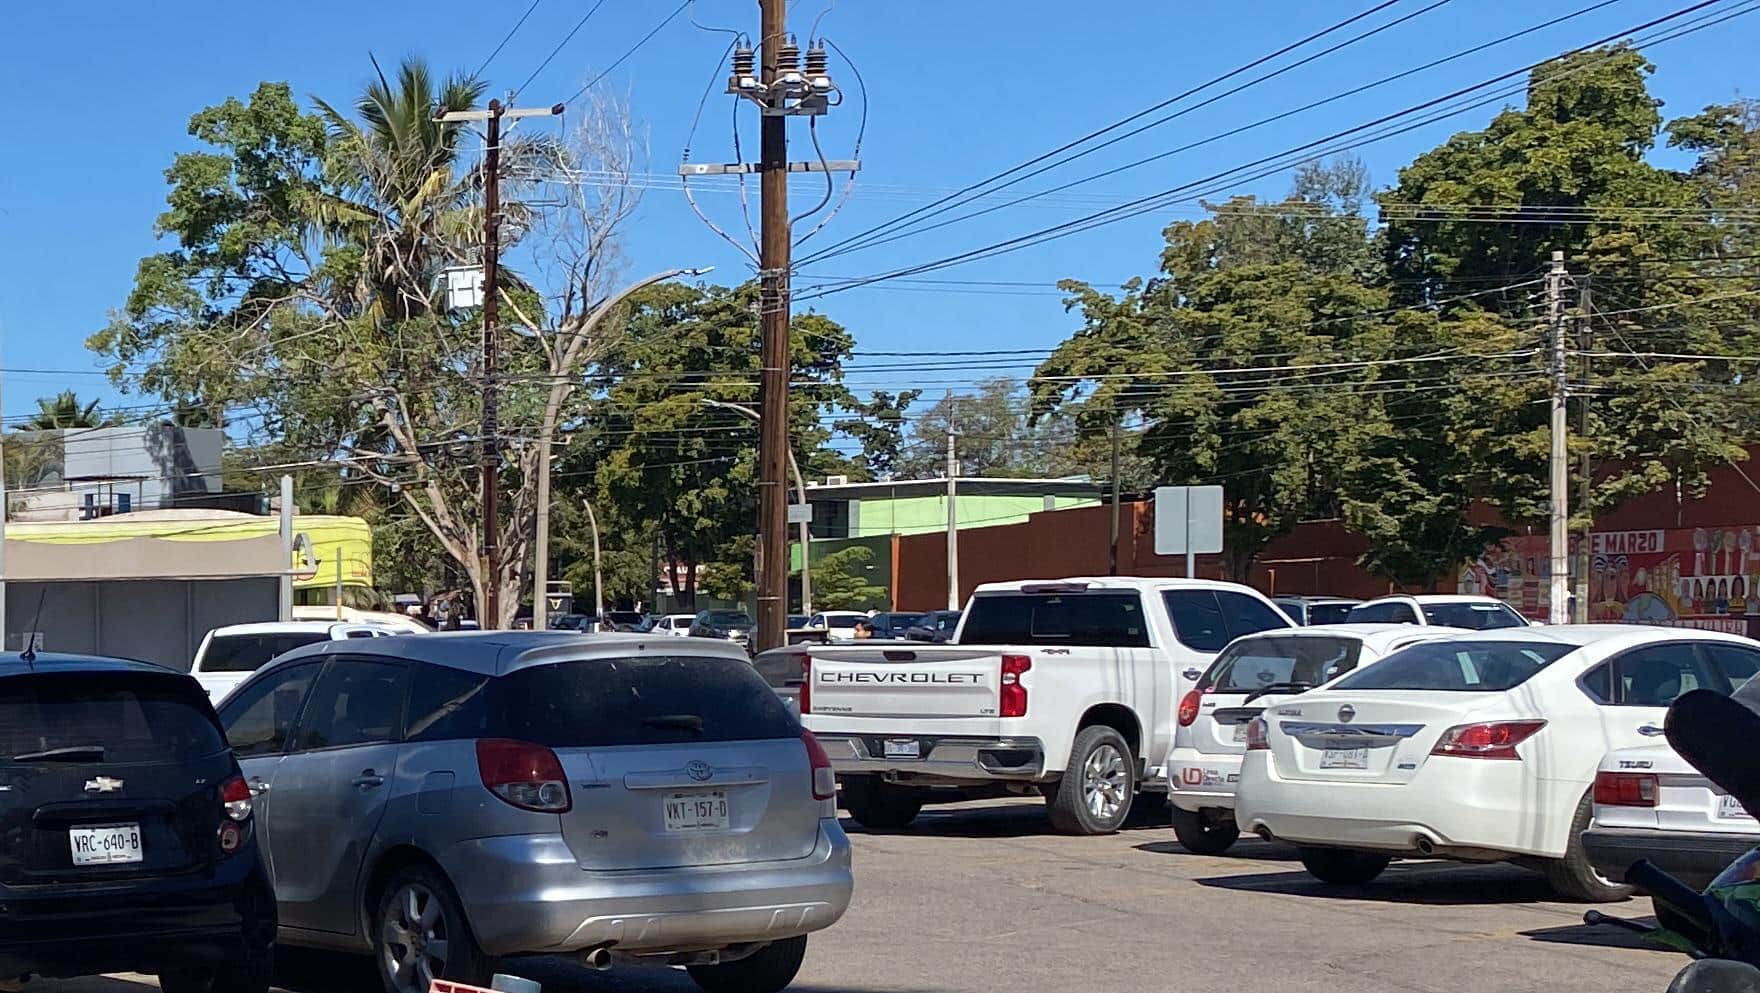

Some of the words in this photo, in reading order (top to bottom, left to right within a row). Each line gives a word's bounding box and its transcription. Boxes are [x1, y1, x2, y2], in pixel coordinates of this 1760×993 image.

[1605, 531, 1658, 554] MARZO
[820, 672, 984, 684] CHEVROLET
[666, 800, 727, 820] VKT-157-D
[74, 832, 139, 853] VRC-640-B
